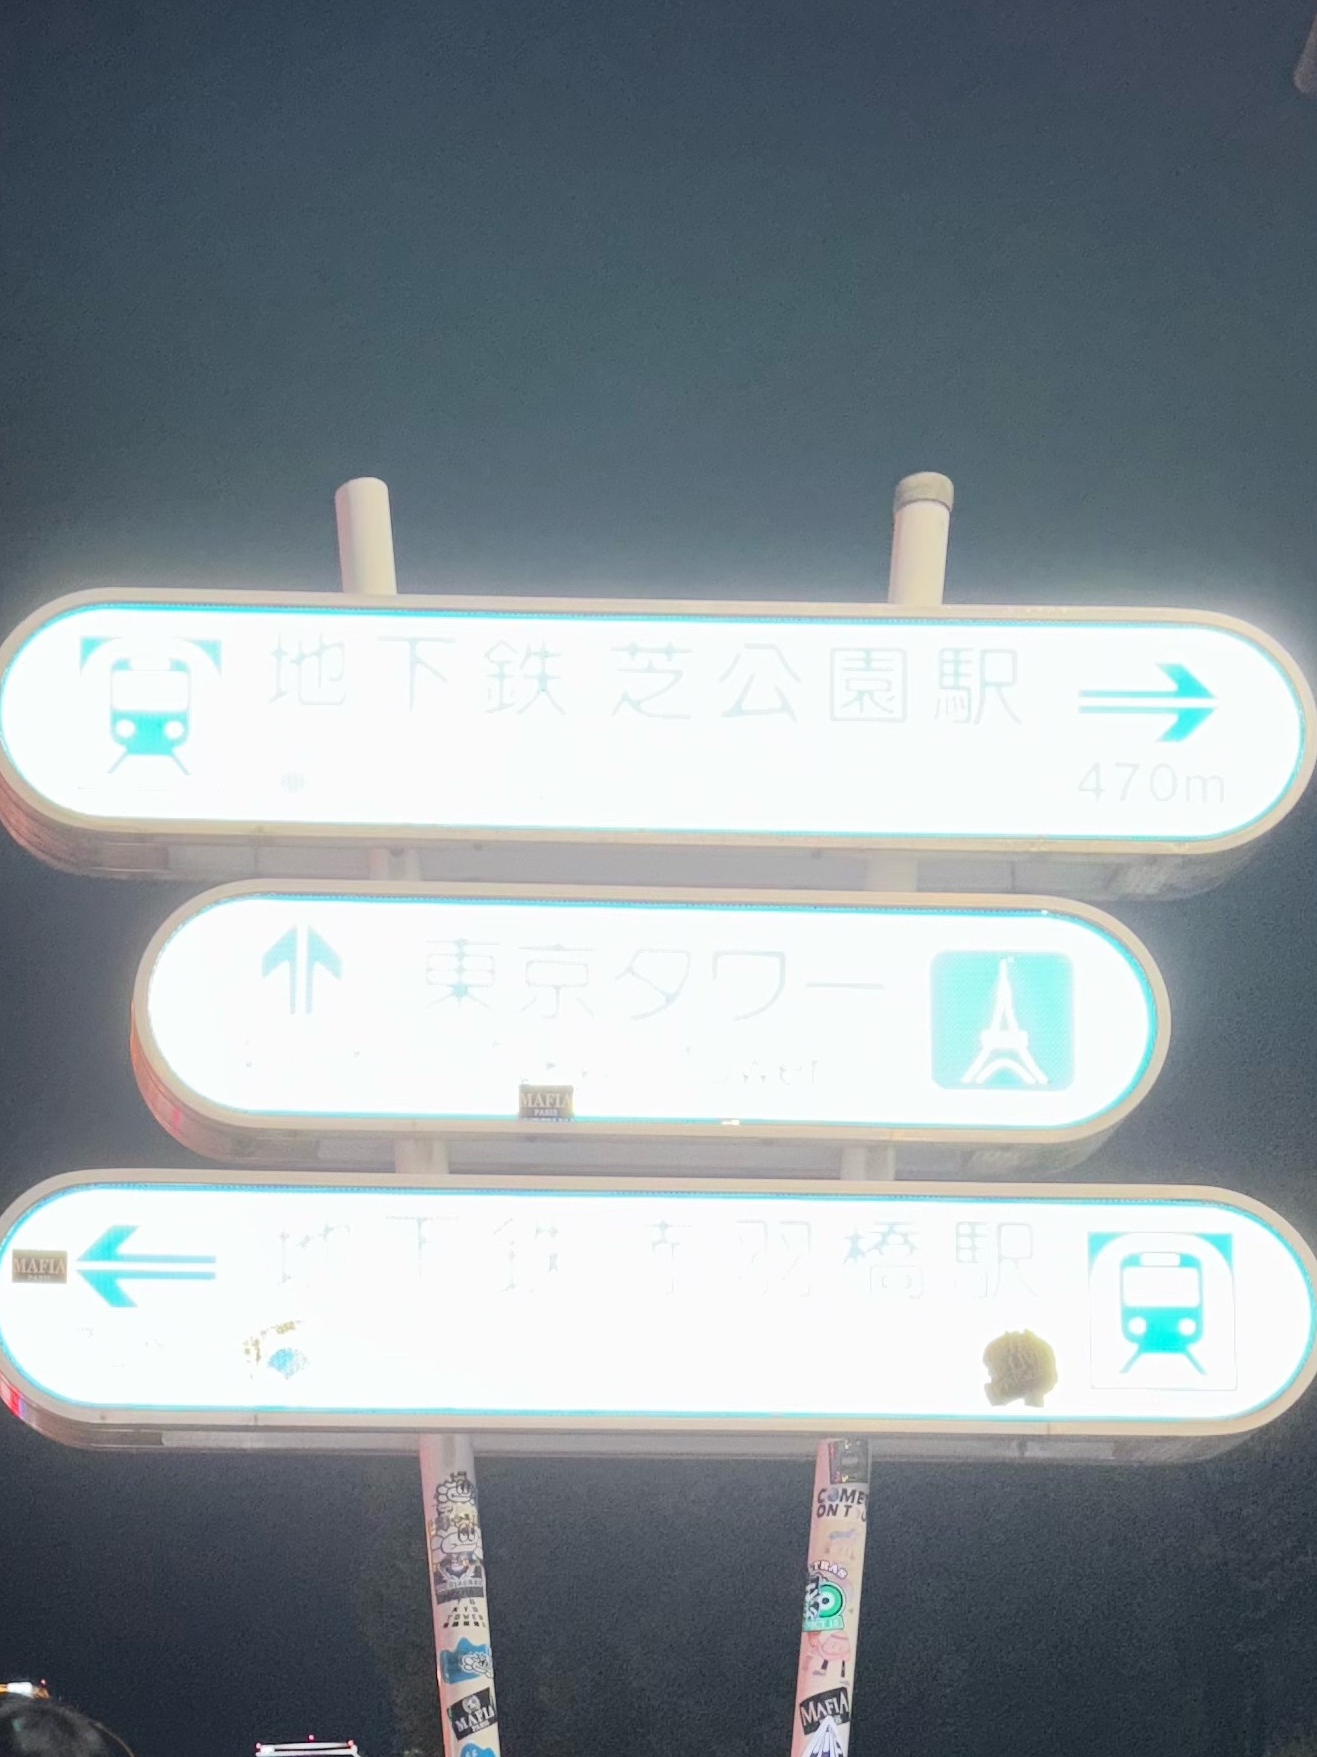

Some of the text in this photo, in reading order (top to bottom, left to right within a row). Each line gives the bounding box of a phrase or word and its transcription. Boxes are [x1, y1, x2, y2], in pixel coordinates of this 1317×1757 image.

[1078, 761, 1226, 803] 470m
[425, 938, 885, 1021] 東京タワー
[521, 1092, 572, 1108] MAFIA
[14, 1258, 66, 1274] MAFIA
[816, 1503, 839, 1518] ON
[455, 1704, 495, 1732] MAFIA
[801, 1691, 849, 1727] MAFIA
